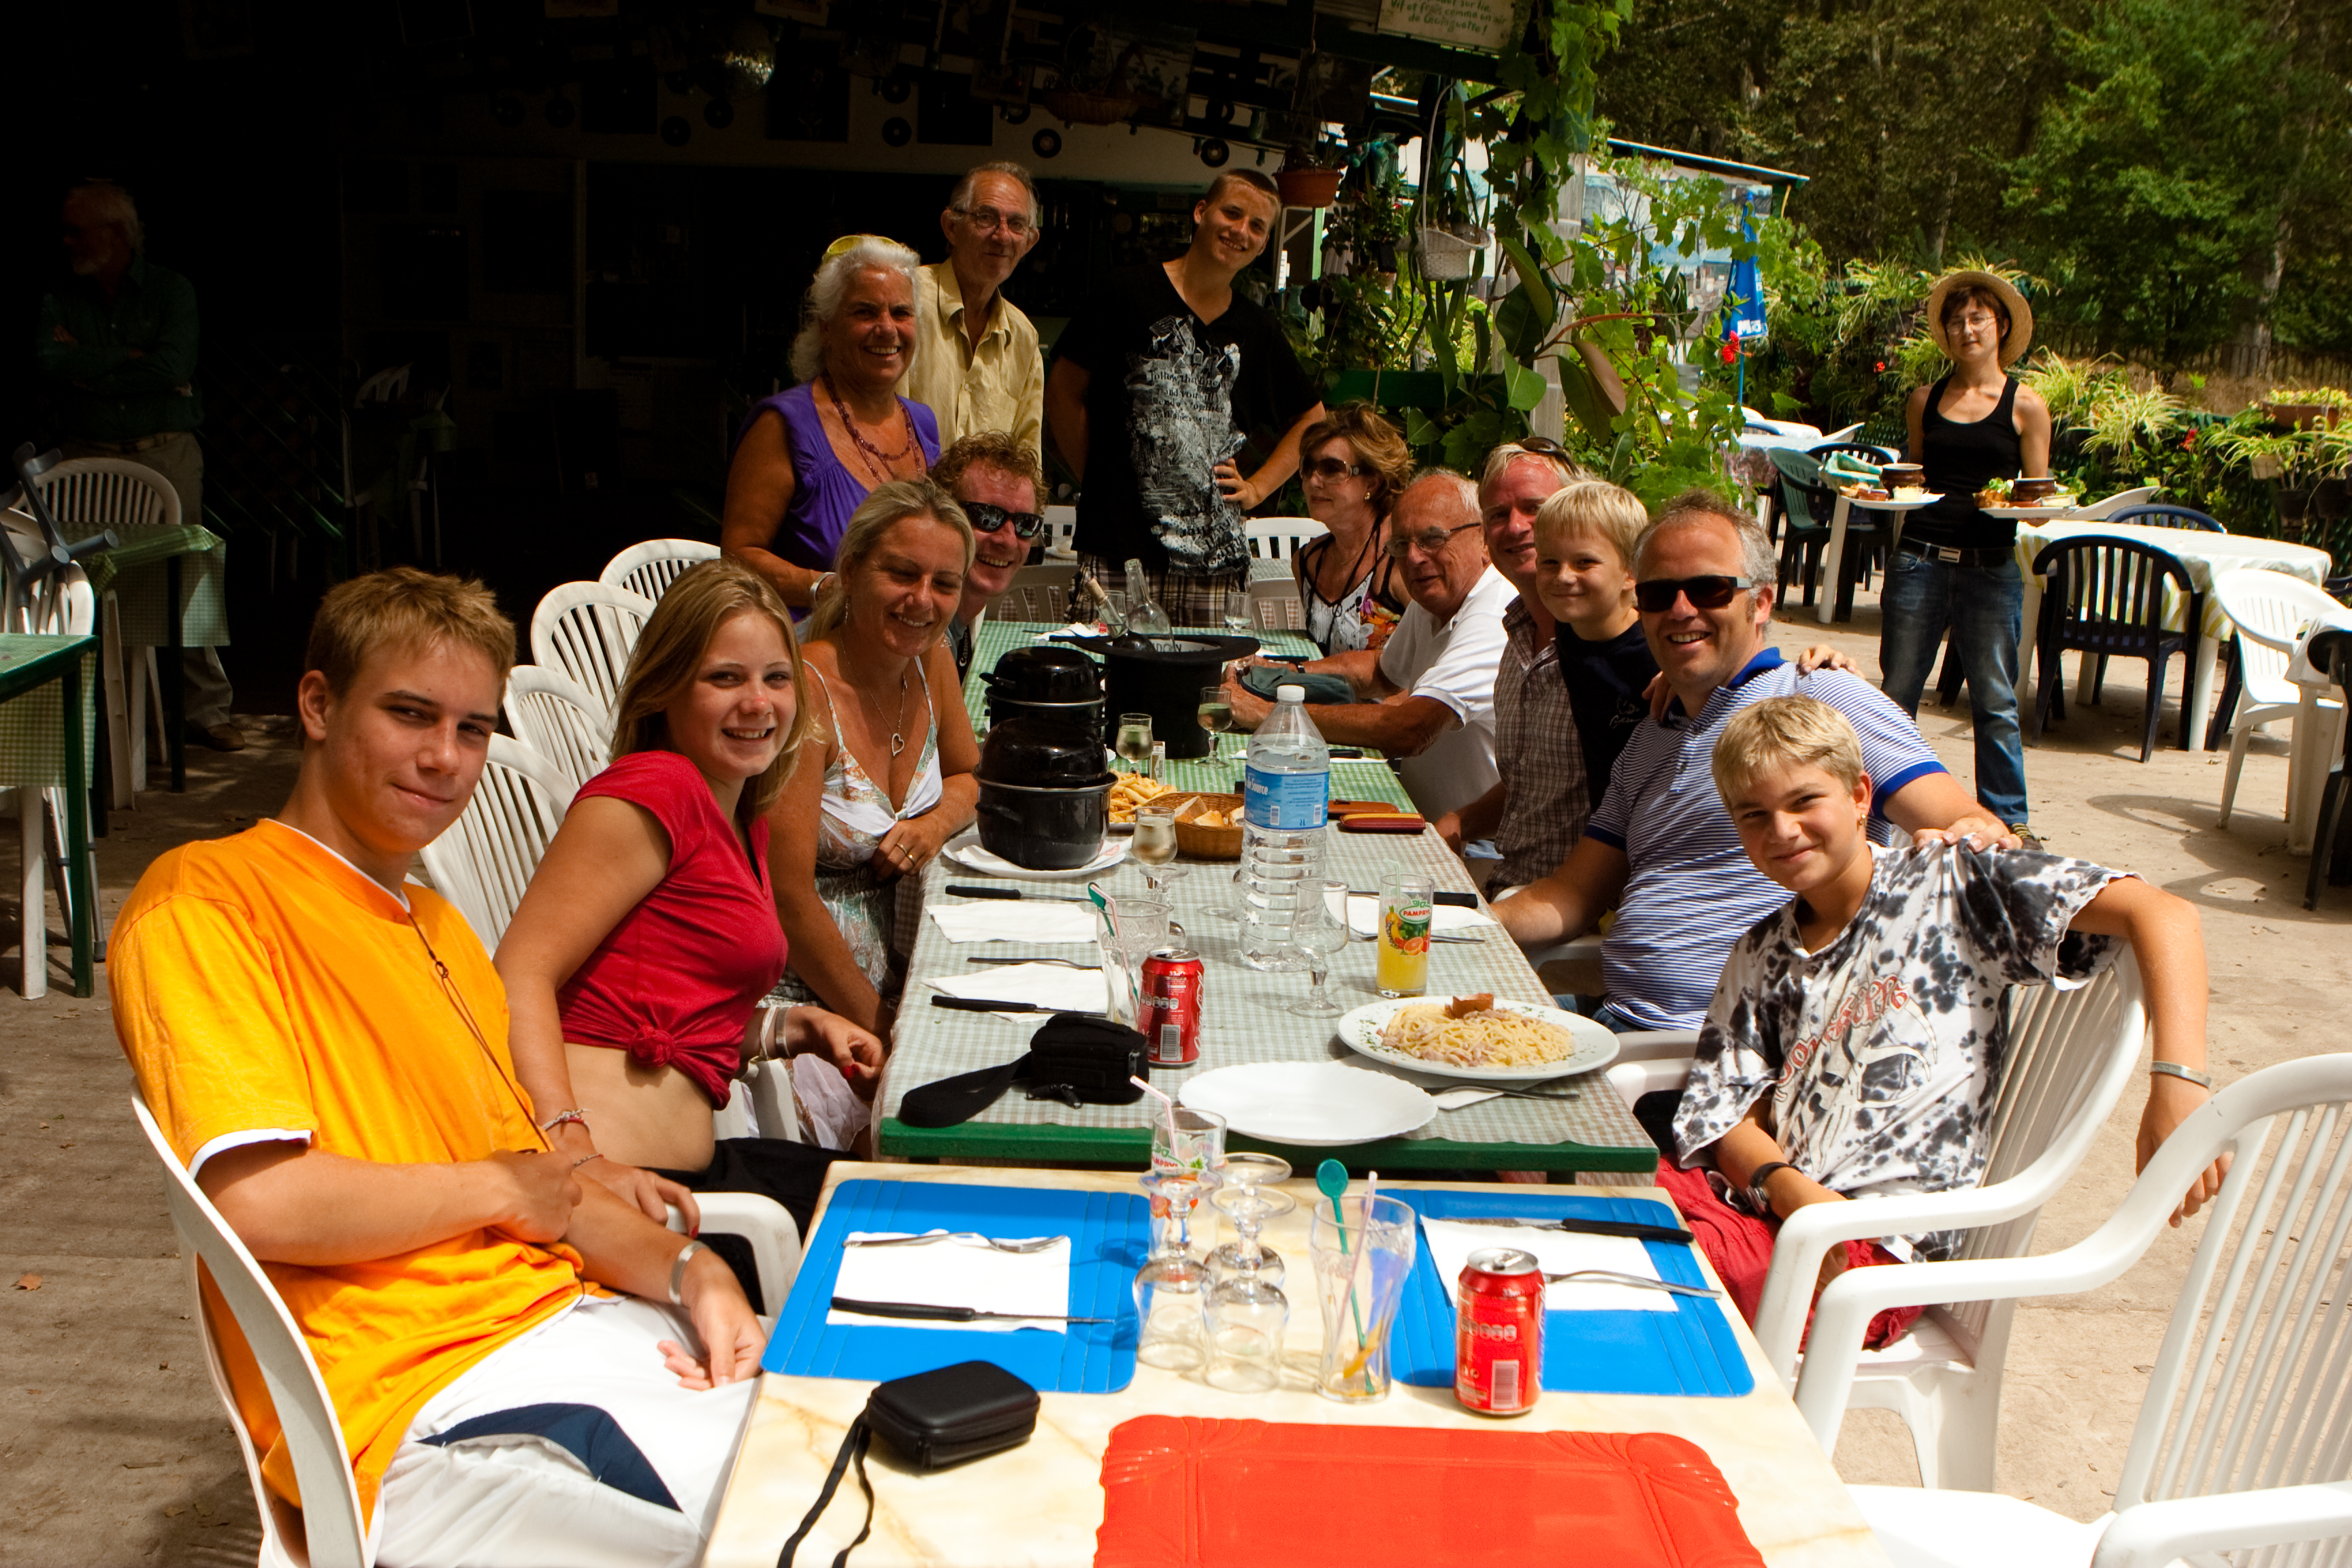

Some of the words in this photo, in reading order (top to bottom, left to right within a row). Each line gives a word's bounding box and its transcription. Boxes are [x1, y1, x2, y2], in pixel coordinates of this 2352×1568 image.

[1407, 3, 1418, 12] et
[1444, 9, 1477, 19] comme
[1408, 13, 1420, 22] de
[1251, 777, 1269, 796] Source
[1403, 907, 1431, 917] PAMPRYL
